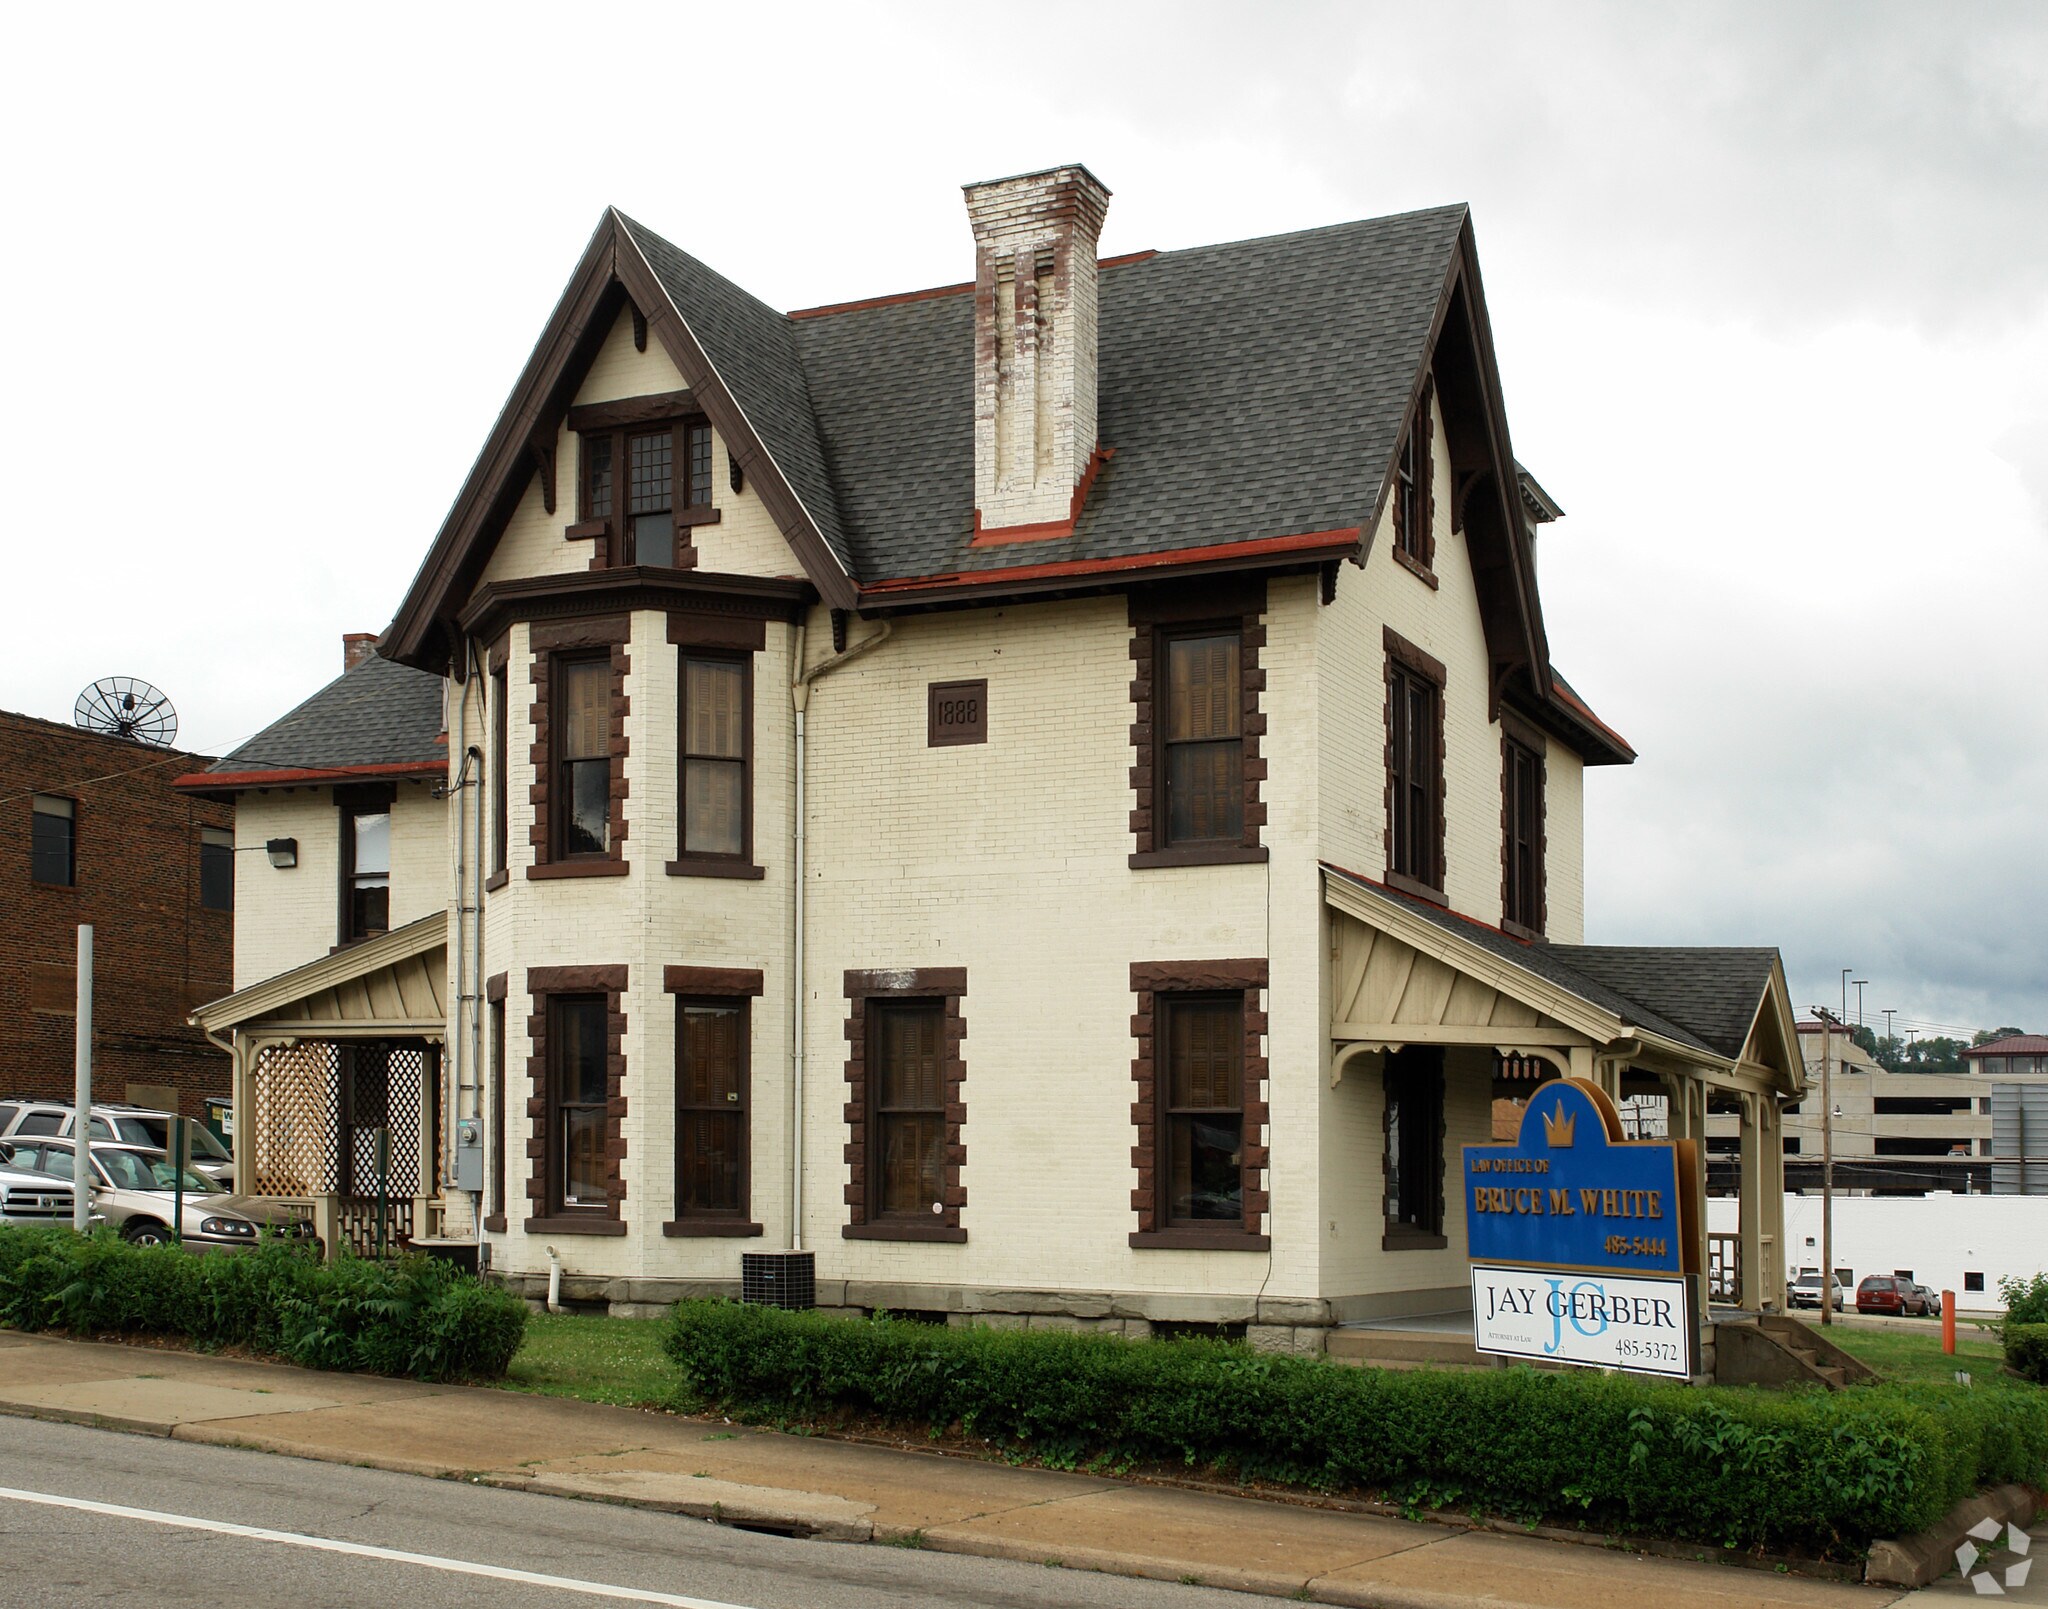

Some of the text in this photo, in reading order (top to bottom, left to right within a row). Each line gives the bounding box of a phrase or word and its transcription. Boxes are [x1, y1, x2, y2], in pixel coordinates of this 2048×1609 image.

[939, 699, 977, 725] 1888
[1471, 1159, 1549, 1173] LAW OFFICE OF
[1474, 1187, 1663, 1218] BRUCE M. WHITE
[1605, 1236, 1666, 1256] 485-5444
[1486, 1286, 1676, 1328] JAY GERBER
[1615, 1339, 1678, 1361] 485-5372
